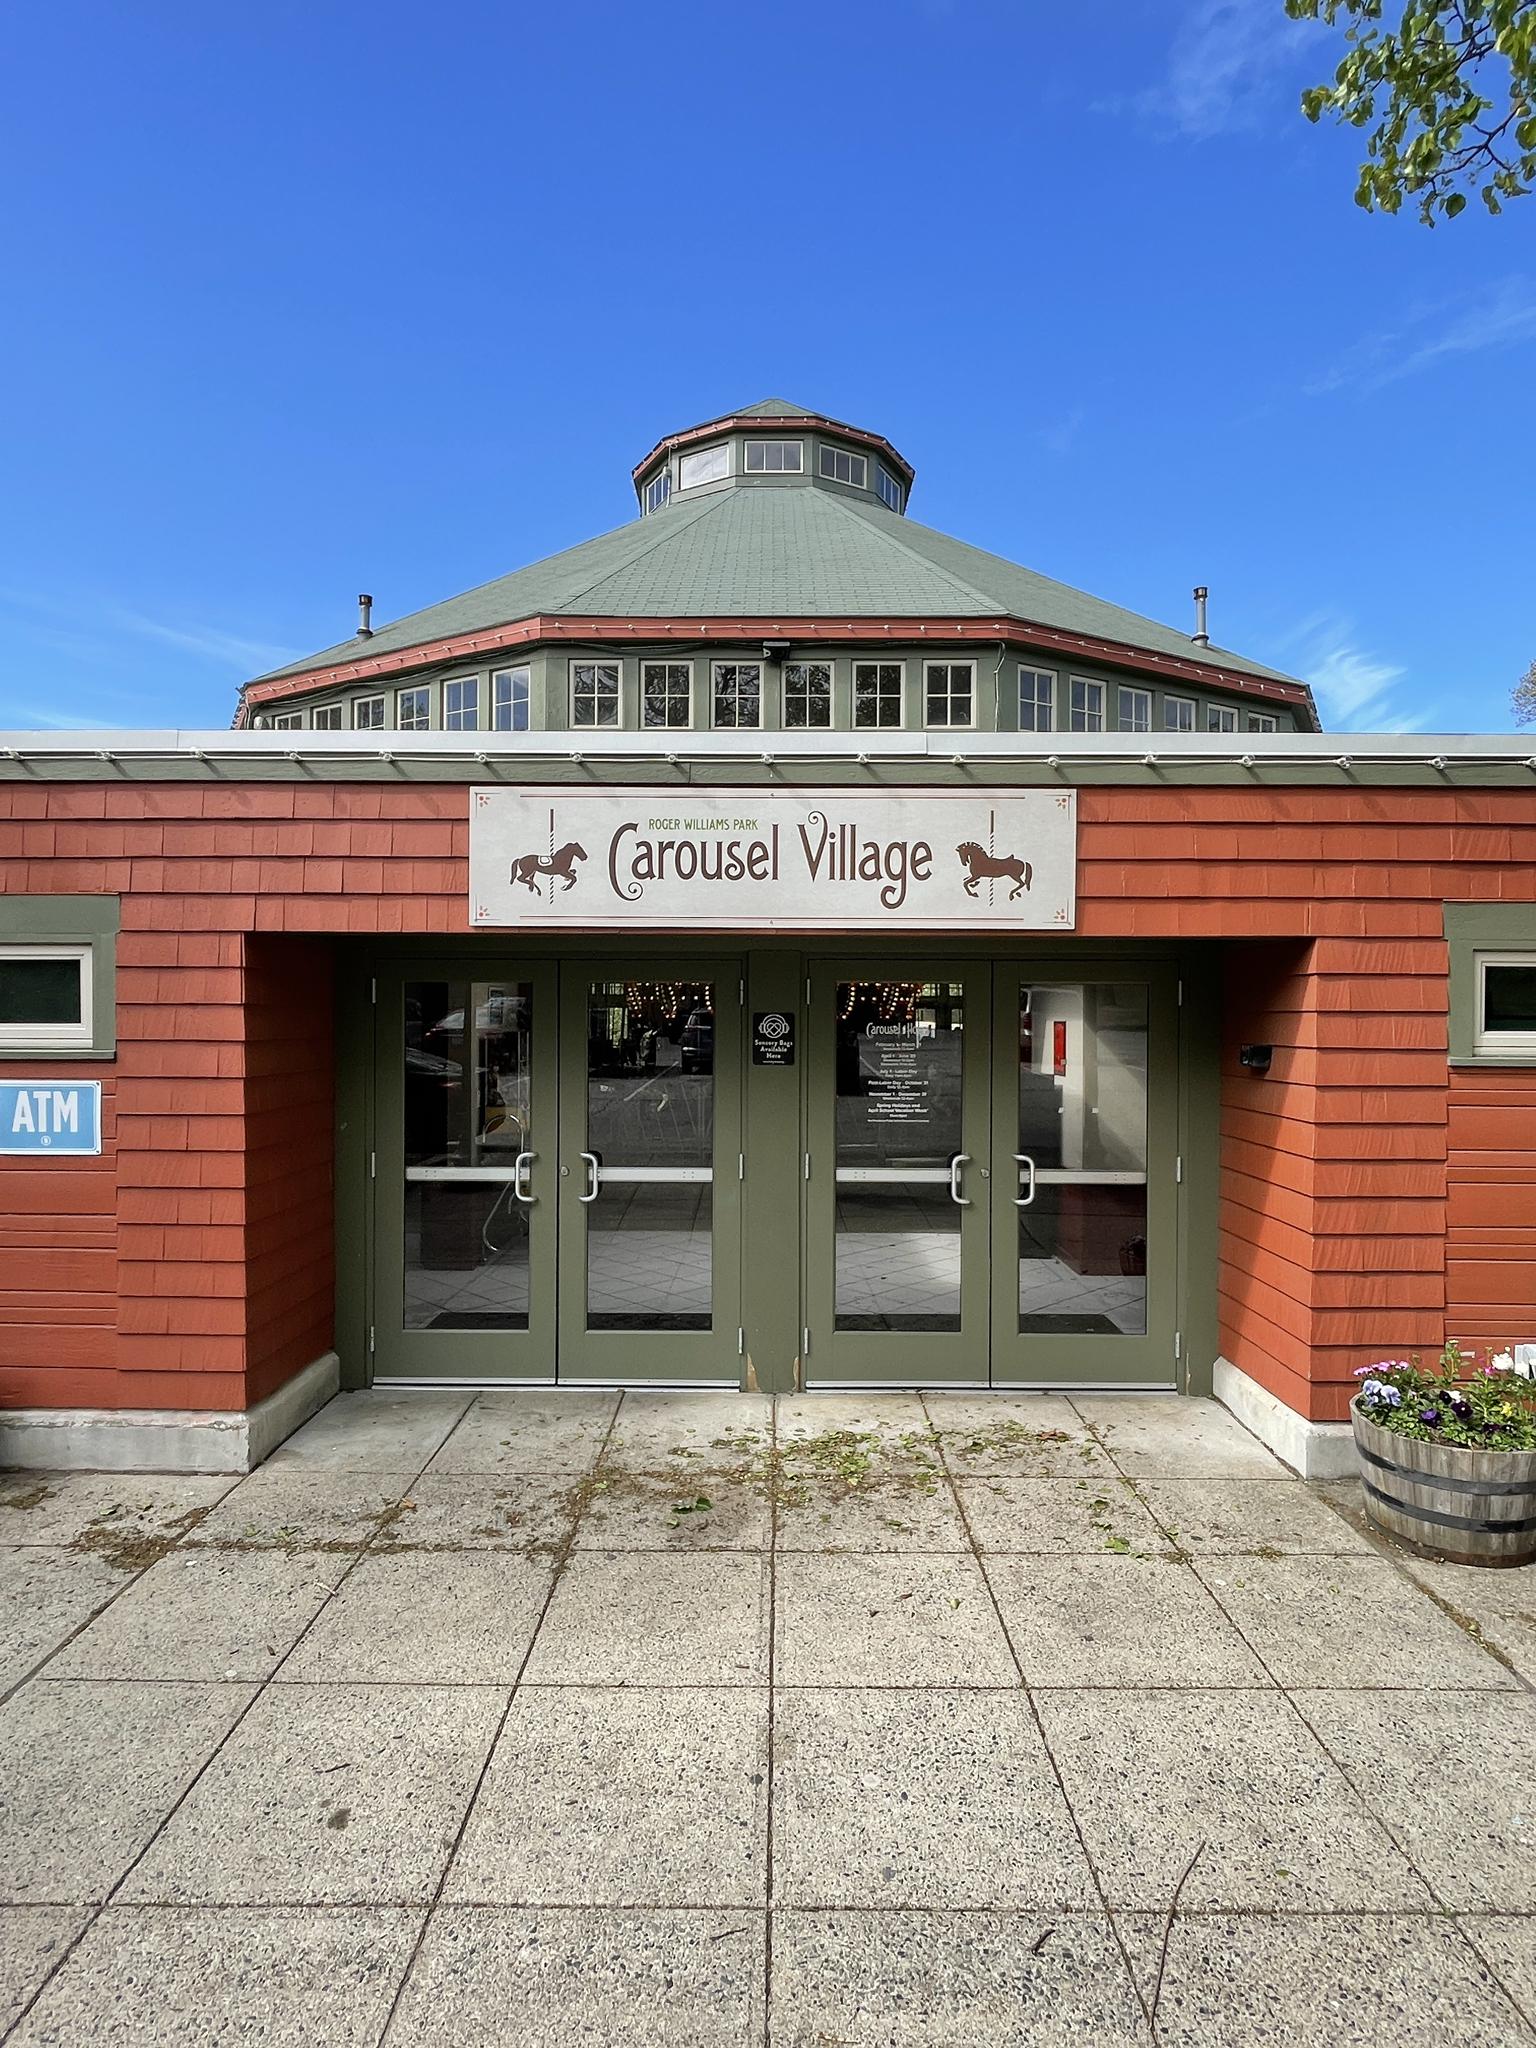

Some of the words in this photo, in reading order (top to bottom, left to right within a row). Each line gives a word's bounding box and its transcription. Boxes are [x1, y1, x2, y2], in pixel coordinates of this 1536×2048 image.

[648, 818, 681, 831] ROGER
[683, 818, 730, 831] WILLIAMS
[733, 818, 759, 831] PARK
[608, 822, 779, 901] Carousel
[796, 810, 933, 910] Village
[866, 1022, 901, 1039] Carousel
[754, 1039, 778, 1048] Sensory
[779, 1039, 793, 1048] Bags
[12, 1090, 79, 1133] ATM
